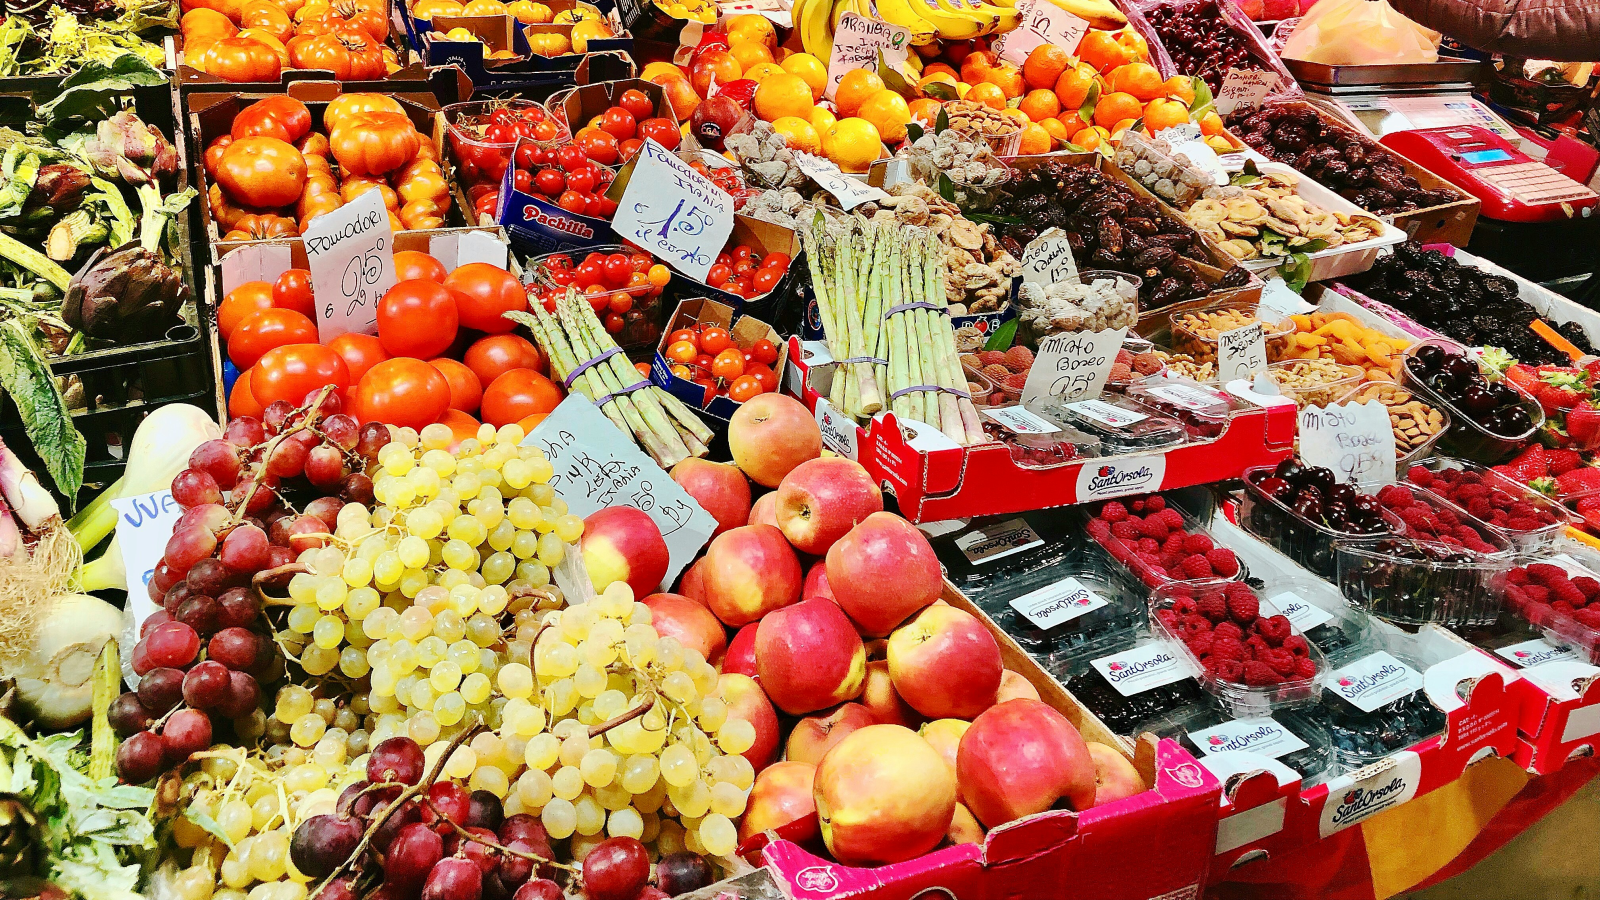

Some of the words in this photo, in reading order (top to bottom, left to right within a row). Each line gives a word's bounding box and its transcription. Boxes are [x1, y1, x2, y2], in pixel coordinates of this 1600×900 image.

[1087, 465, 1153, 491] SantOrsola
[968, 528, 1031, 555] SantOrsola
[1034, 588, 1090, 619] SantOrsola
[1109, 653, 1174, 682] SantOrsola
[1341, 664, 1402, 699] SantOrsola
[1332, 777, 1404, 823] SantOrsola
